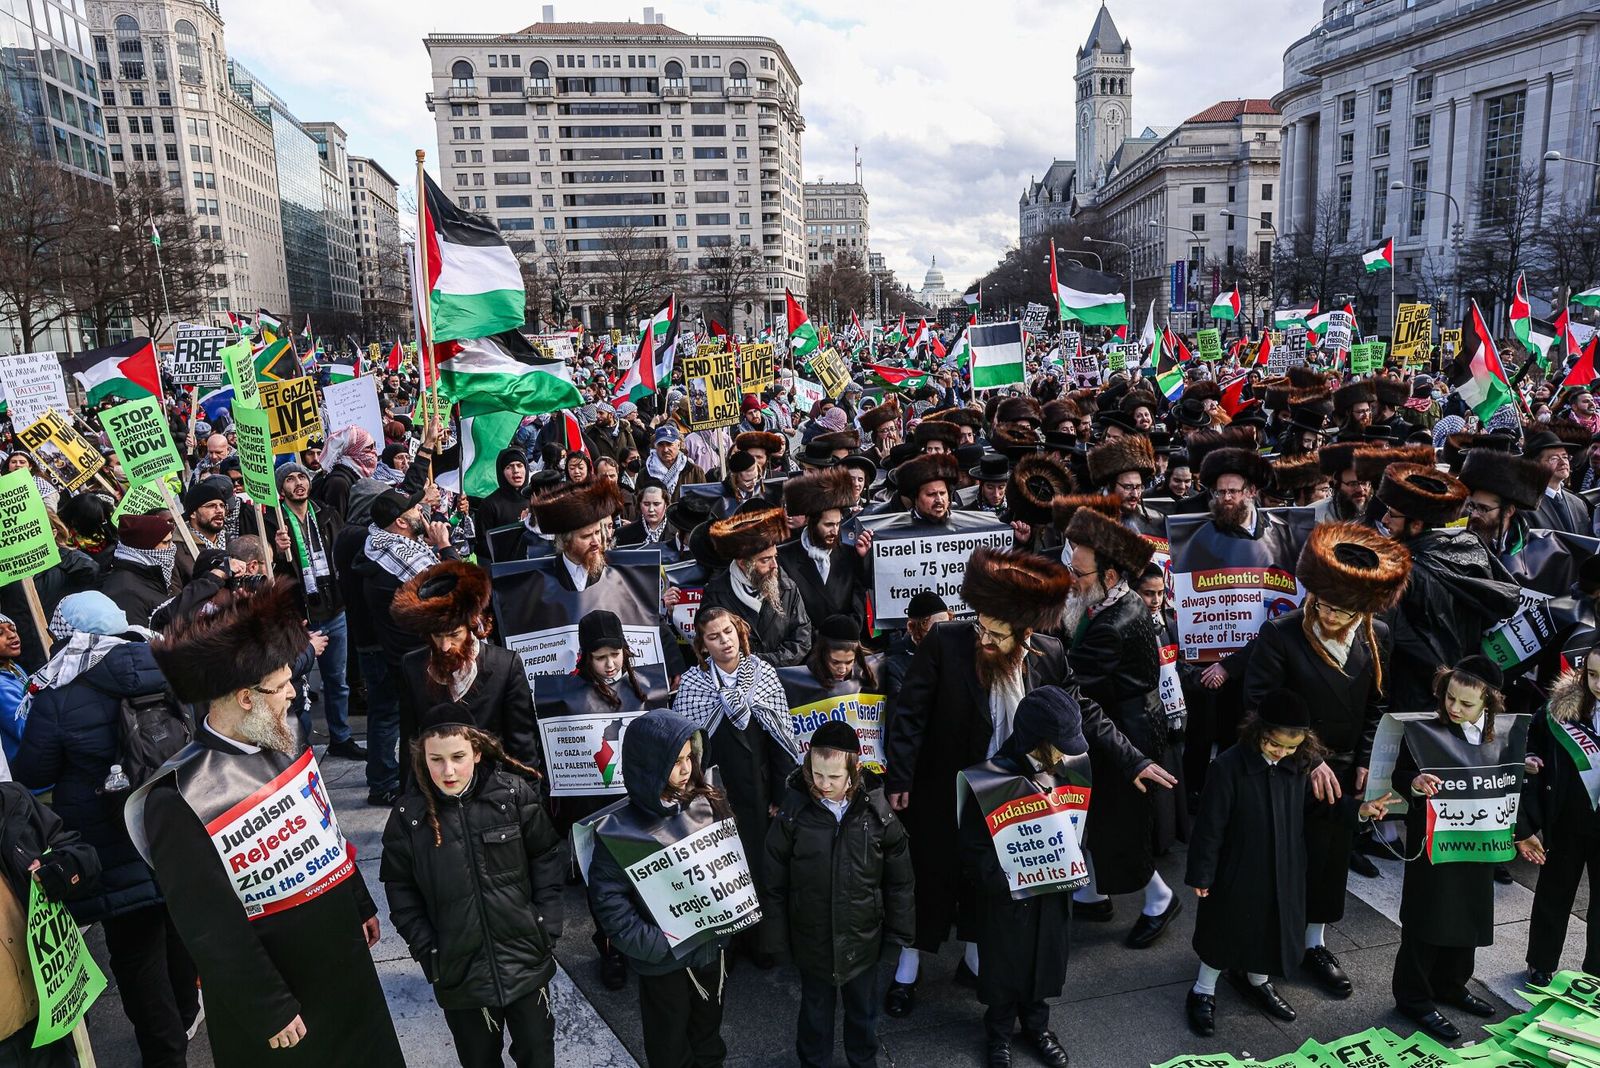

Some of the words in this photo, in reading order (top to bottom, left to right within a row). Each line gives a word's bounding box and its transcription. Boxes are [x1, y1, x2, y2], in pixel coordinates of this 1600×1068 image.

[1025, 311, 1048, 321] FREE
[1398, 312, 1414, 322] LET
[1200, 338, 1218, 346] KIDS
[1444, 332, 1460, 342] END
[175, 338, 226, 362] FREE
[742, 350, 754, 362] LET
[756, 346, 772, 359] GAZA
[1116, 346, 1138, 356] FREE
[174, 362, 222, 374] PALESTINE!
[686, 359, 711, 378] END
[713, 355, 734, 373] THE
[742, 356, 773, 382] LIVE!
[814, 362, 826, 375] LET
[1072, 357, 1096, 368] FREE
[710, 372, 735, 390] WAR
[16, 385, 52, 396] PALESTINE
[282, 380, 312, 403] GAZA
[724, 388, 737, 404] ON
[108, 406, 154, 432] STOP
[714, 403, 739, 420] GAZA
[21, 422, 52, 449] END
[116, 419, 160, 441] FUNDING
[120, 427, 163, 448] APARTHEID
[122, 434, 168, 462] NOW
[250, 437, 264, 445] HIDE
[132, 468, 144, 478] FOR
[144, 457, 176, 475] PALESTINE
[246, 454, 266, 464] WITH
[0, 492, 30, 508] ROUGHT
[128, 498, 140, 508] YOU
[146, 490, 164, 502] BIDEN
[4, 502, 27, 516] YOU
[2, 518, 40, 538] AMERICAN
[3, 516, 18, 528] BY
[876, 541, 916, 558] Israel
[920, 540, 932, 554] is
[937, 534, 1012, 555] responsible
[0, 562, 12, 572] OR
[12, 548, 50, 568] PALESTINE
[904, 568, 916, 578] for
[920, 561, 937, 576] 75
[1197, 572, 1260, 588] Authentic
[1264, 573, 1295, 590] Rabbis
[949, 604, 967, 612] and
[1182, 594, 1216, 609] always
[1219, 592, 1262, 606] opposed
[1192, 610, 1252, 624] Zionism
[1530, 604, 1549, 638] estine
[1209, 622, 1223, 631] and
[1224, 622, 1236, 630] the
[516, 643, 538, 654] Judaism
[540, 638, 566, 650] Demands
[1184, 633, 1214, 645] State
[1216, 632, 1228, 643] of
[524, 652, 557, 667] FREEDOM
[1162, 676, 1172, 688] of
[792, 710, 828, 736] State
[831, 702, 847, 722] of
[848, 700, 885, 721] "Israel"
[548, 726, 568, 734] Judaism
[568, 724, 594, 732] Demands
[557, 736, 586, 744] FREEDOM
[566, 762, 598, 770] PALESTINE
[992, 800, 1048, 828] Judaism
[1439, 802, 1488, 826] عربية
[220, 794, 296, 854] Judaism
[1018, 824, 1042, 837] the
[228, 815, 306, 874] Rejects
[1007, 839, 1044, 854] State
[1048, 831, 1064, 846] of
[1438, 839, 1512, 852] www.nkus
[237, 834, 320, 892] Zionism
[630, 852, 674, 882] Israel
[672, 846, 690, 862] is
[1013, 848, 1066, 868] “Israel”
[244, 886, 276, 903] And
[279, 871, 306, 892] the
[306, 846, 340, 876] State
[672, 881, 684, 891] for
[683, 864, 705, 886] 75
[706, 851, 738, 880] years
[1018, 869, 1045, 886] And
[1047, 867, 1066, 880] its
[669, 895, 710, 918] tragic
[694, 917, 706, 928] of
[709, 910, 732, 925] Arab
[736, 896, 754, 914] and
[29, 902, 52, 934] HOW
[41, 950, 65, 984] DID
[64, 926, 80, 958] YOU
[46, 973, 65, 998] KILL
[50, 1005, 67, 1028] FOR
[68, 970, 90, 1011] PALESTINE
[1347, 1054, 1384, 1068] SIEGE
